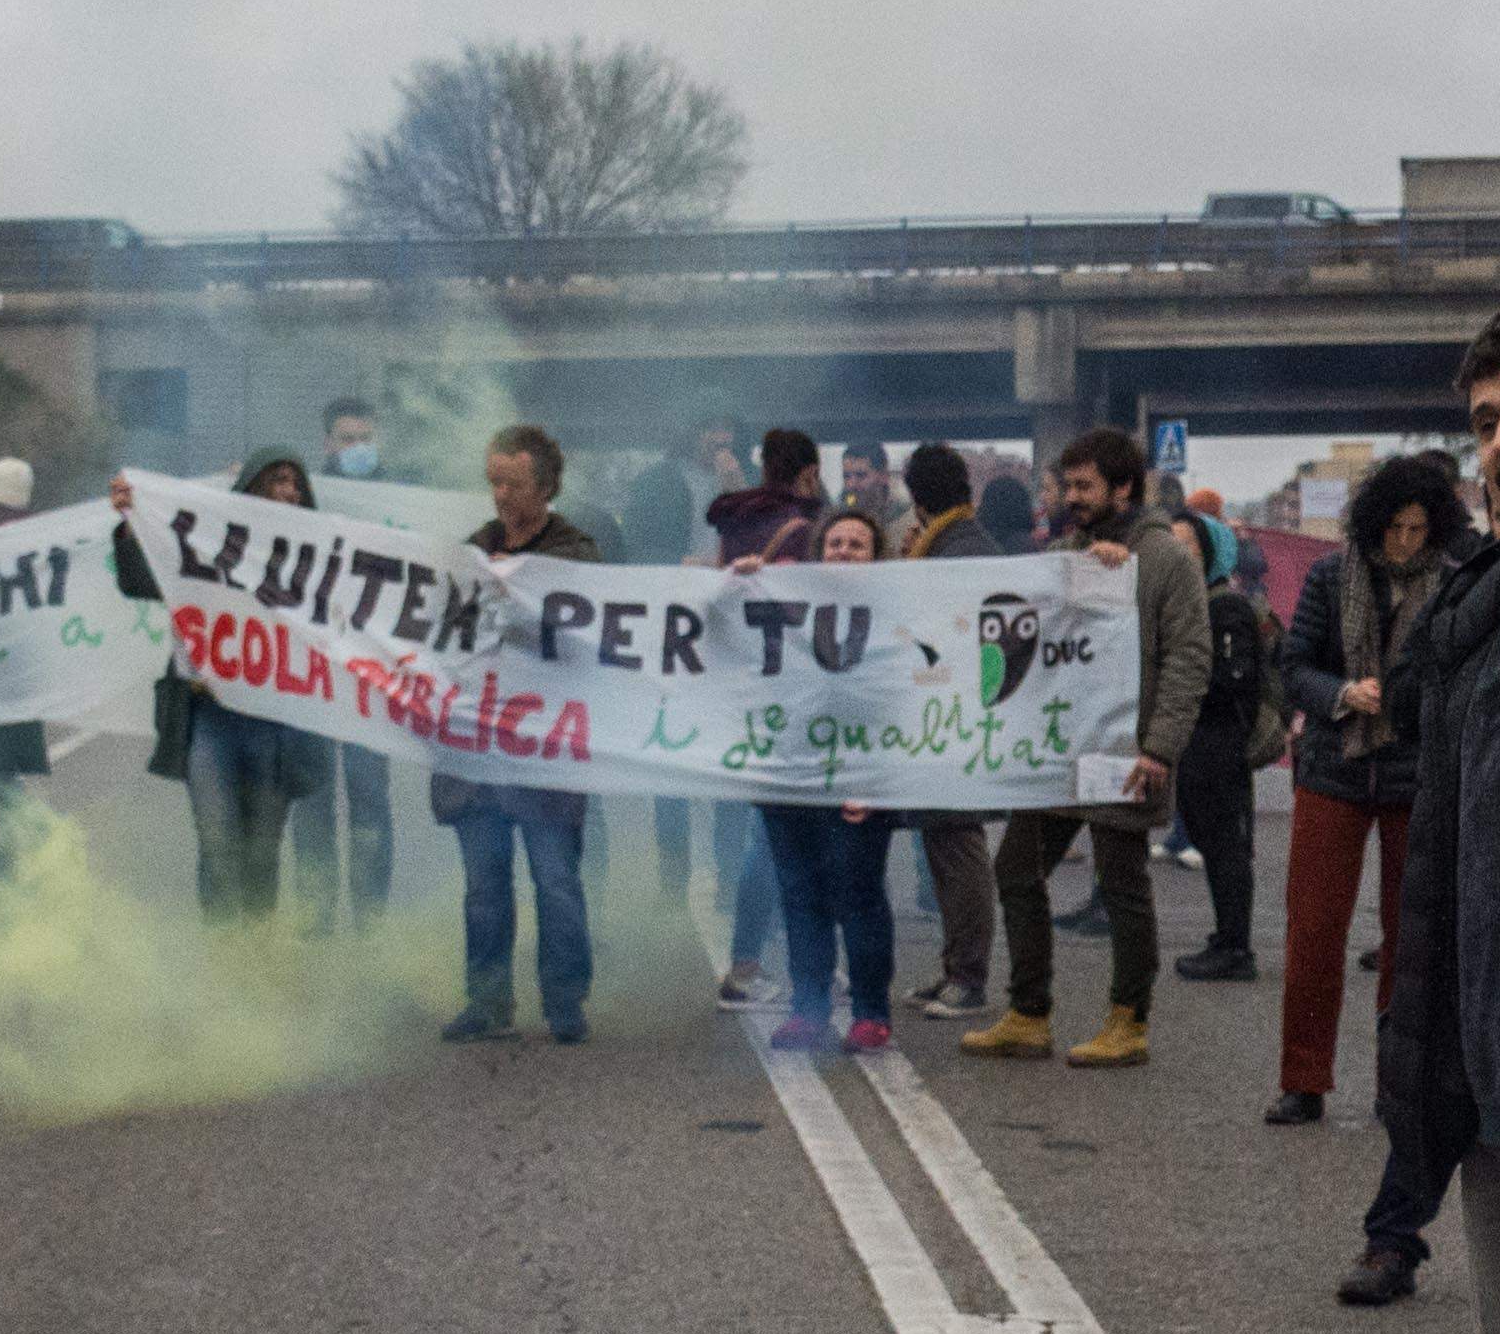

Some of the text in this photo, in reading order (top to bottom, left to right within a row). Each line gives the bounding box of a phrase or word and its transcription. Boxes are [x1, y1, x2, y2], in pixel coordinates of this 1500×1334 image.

[540, 590, 705, 675] PER
[744, 599, 872, 676] TU
[807, 692, 1073, 791] qualitat
